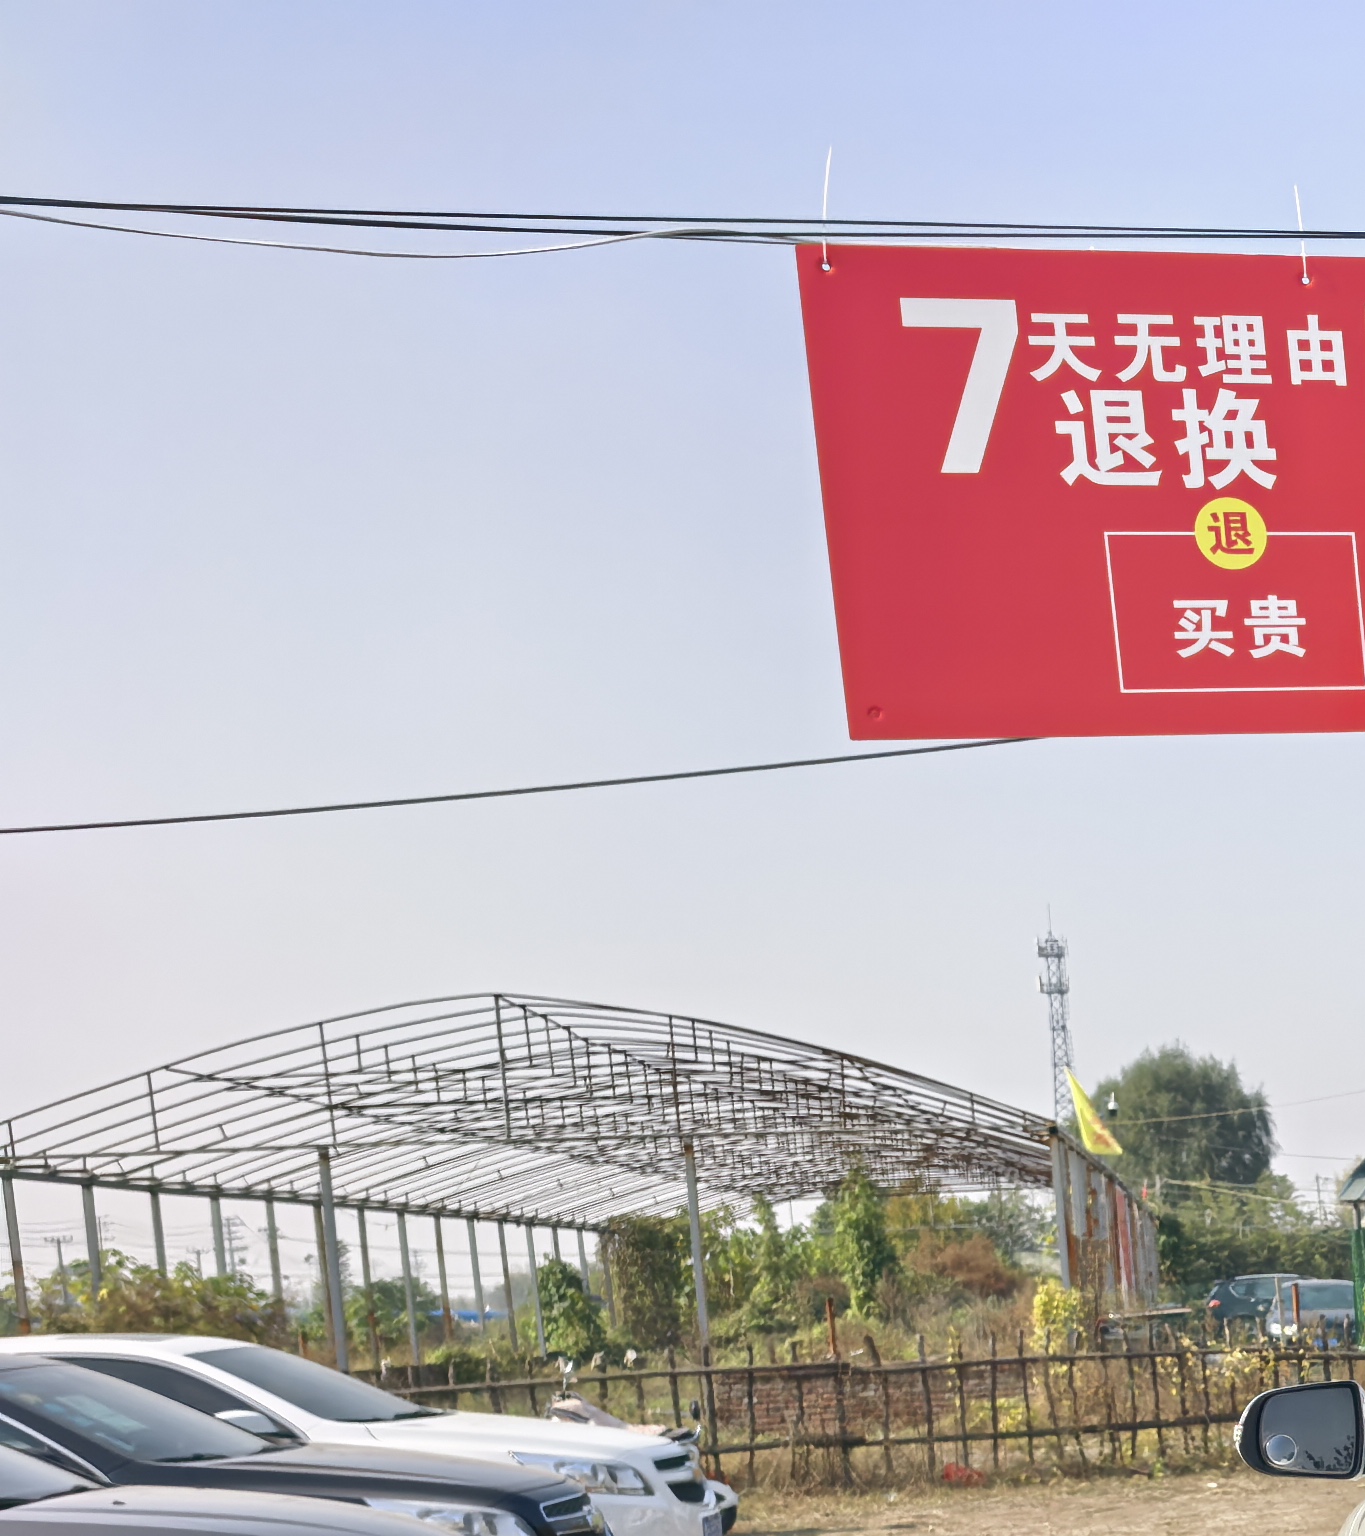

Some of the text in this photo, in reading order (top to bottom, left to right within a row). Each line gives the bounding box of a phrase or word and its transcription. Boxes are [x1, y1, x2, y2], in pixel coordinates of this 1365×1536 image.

[1028, 313, 1347, 386] 天无理由
[1054, 388, 1277, 490] 退换
[1206, 511, 1256, 556] 退
[1172, 595, 1306, 659] 买贵
